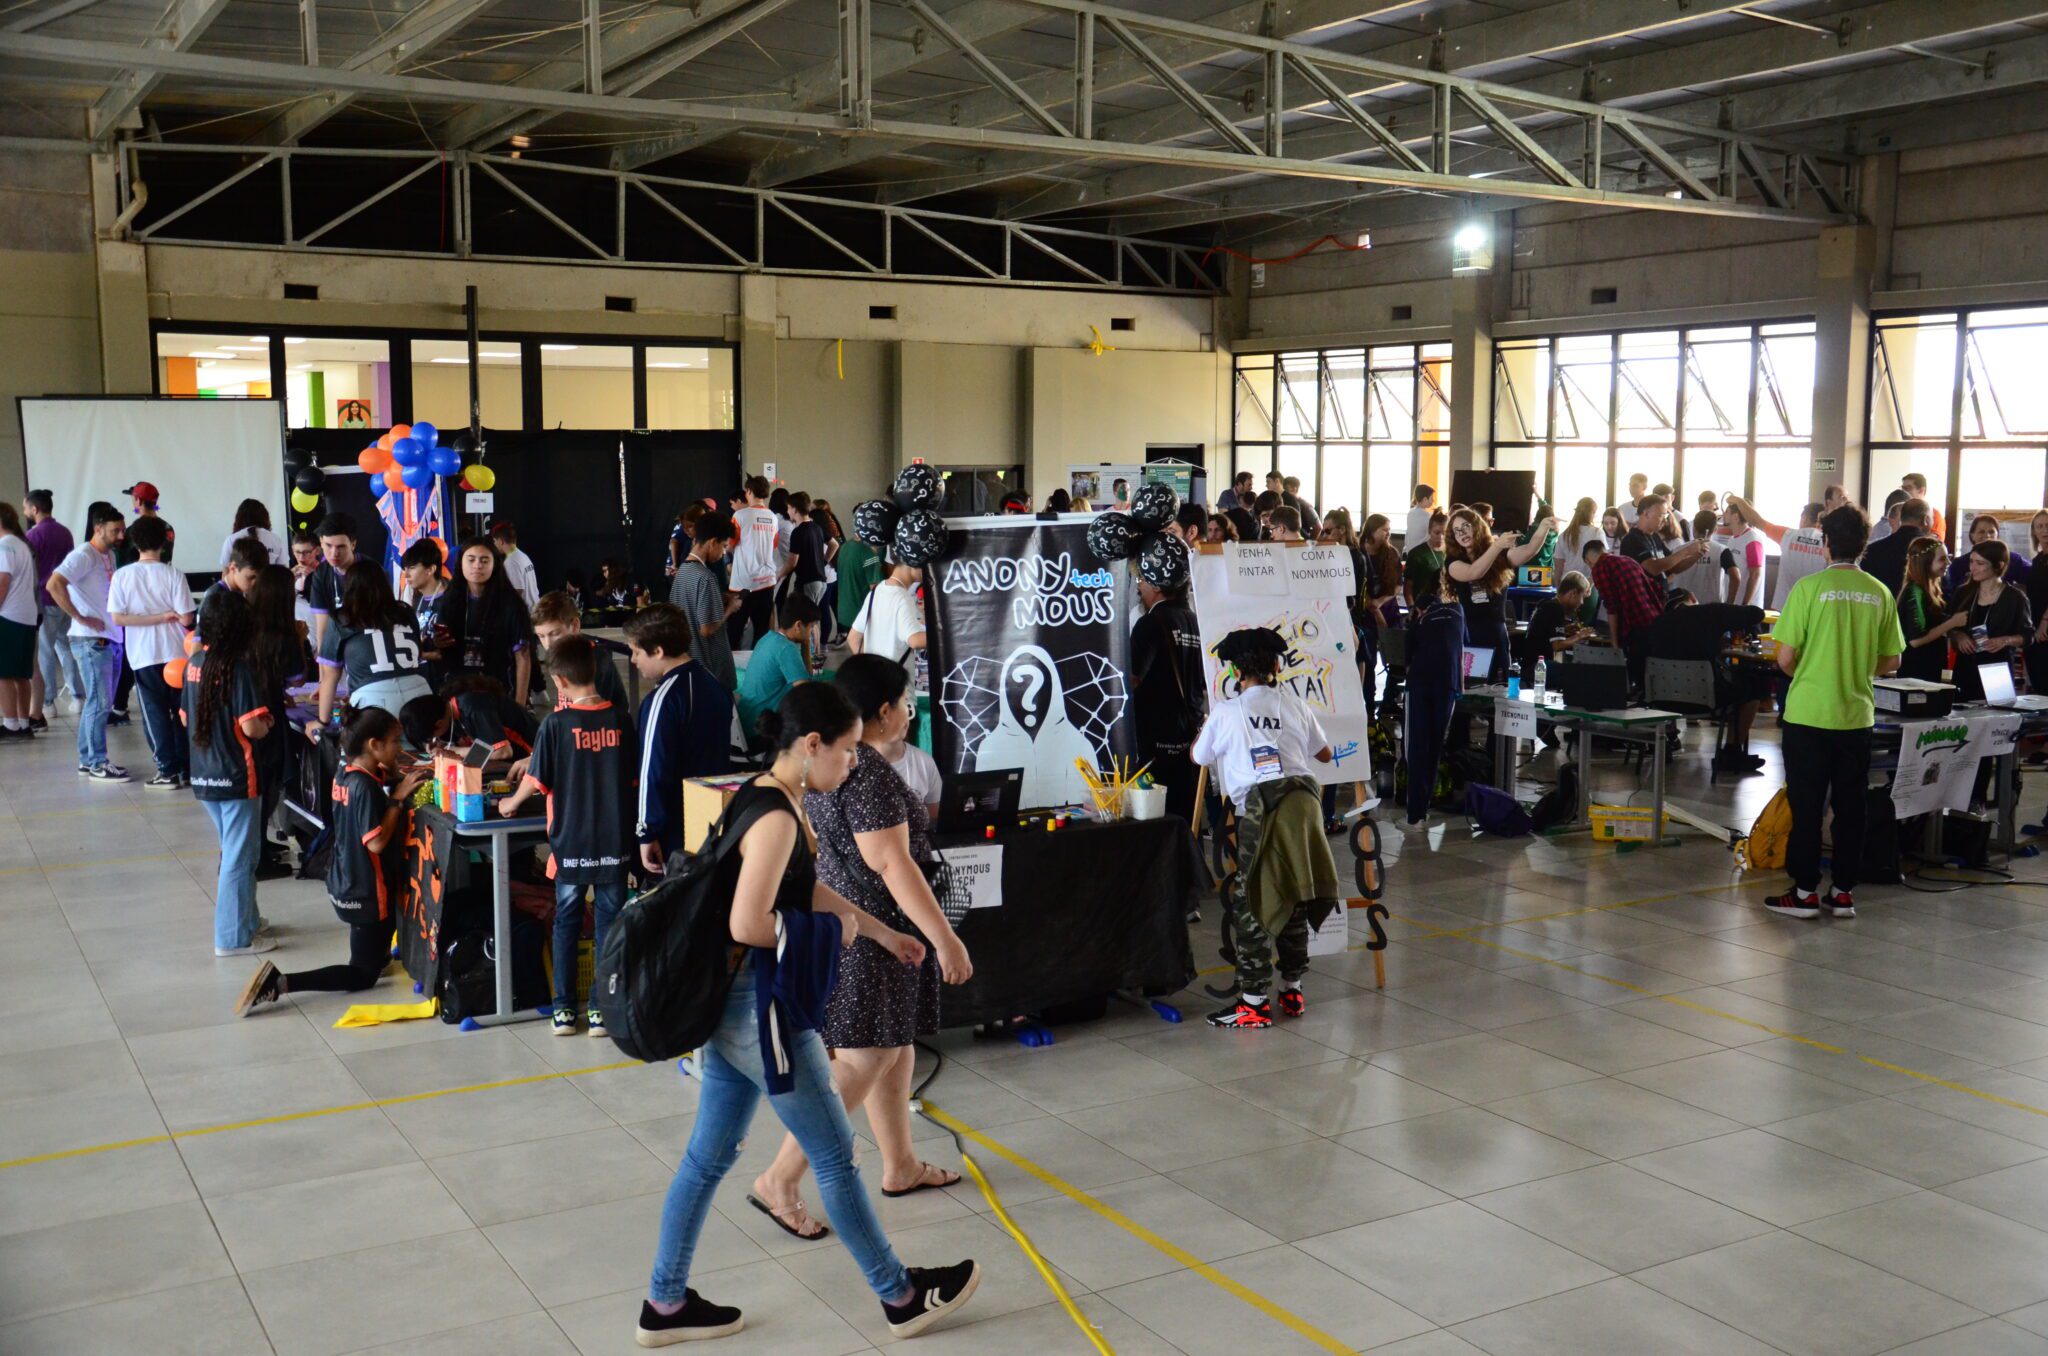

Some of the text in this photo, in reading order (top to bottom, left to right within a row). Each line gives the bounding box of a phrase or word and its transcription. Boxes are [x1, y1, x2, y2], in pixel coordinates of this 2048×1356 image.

[1237, 547, 1272, 558] VENHA
[1301, 550, 1335, 561] COM A
[943, 551, 1071, 597] ANONY
[1069, 568, 1114, 588] tech
[1238, 566, 1275, 577] PINTAR
[1291, 567, 1351, 580] NONYMOUS
[1013, 588, 1114, 630] MOUS
[364, 624, 419, 674] 15
[1248, 716, 1282, 730] VAZ
[571, 727, 622, 752] Taylor
[563, 858, 579, 868] EMEF
[955, 863, 991, 875] NYMOUS
